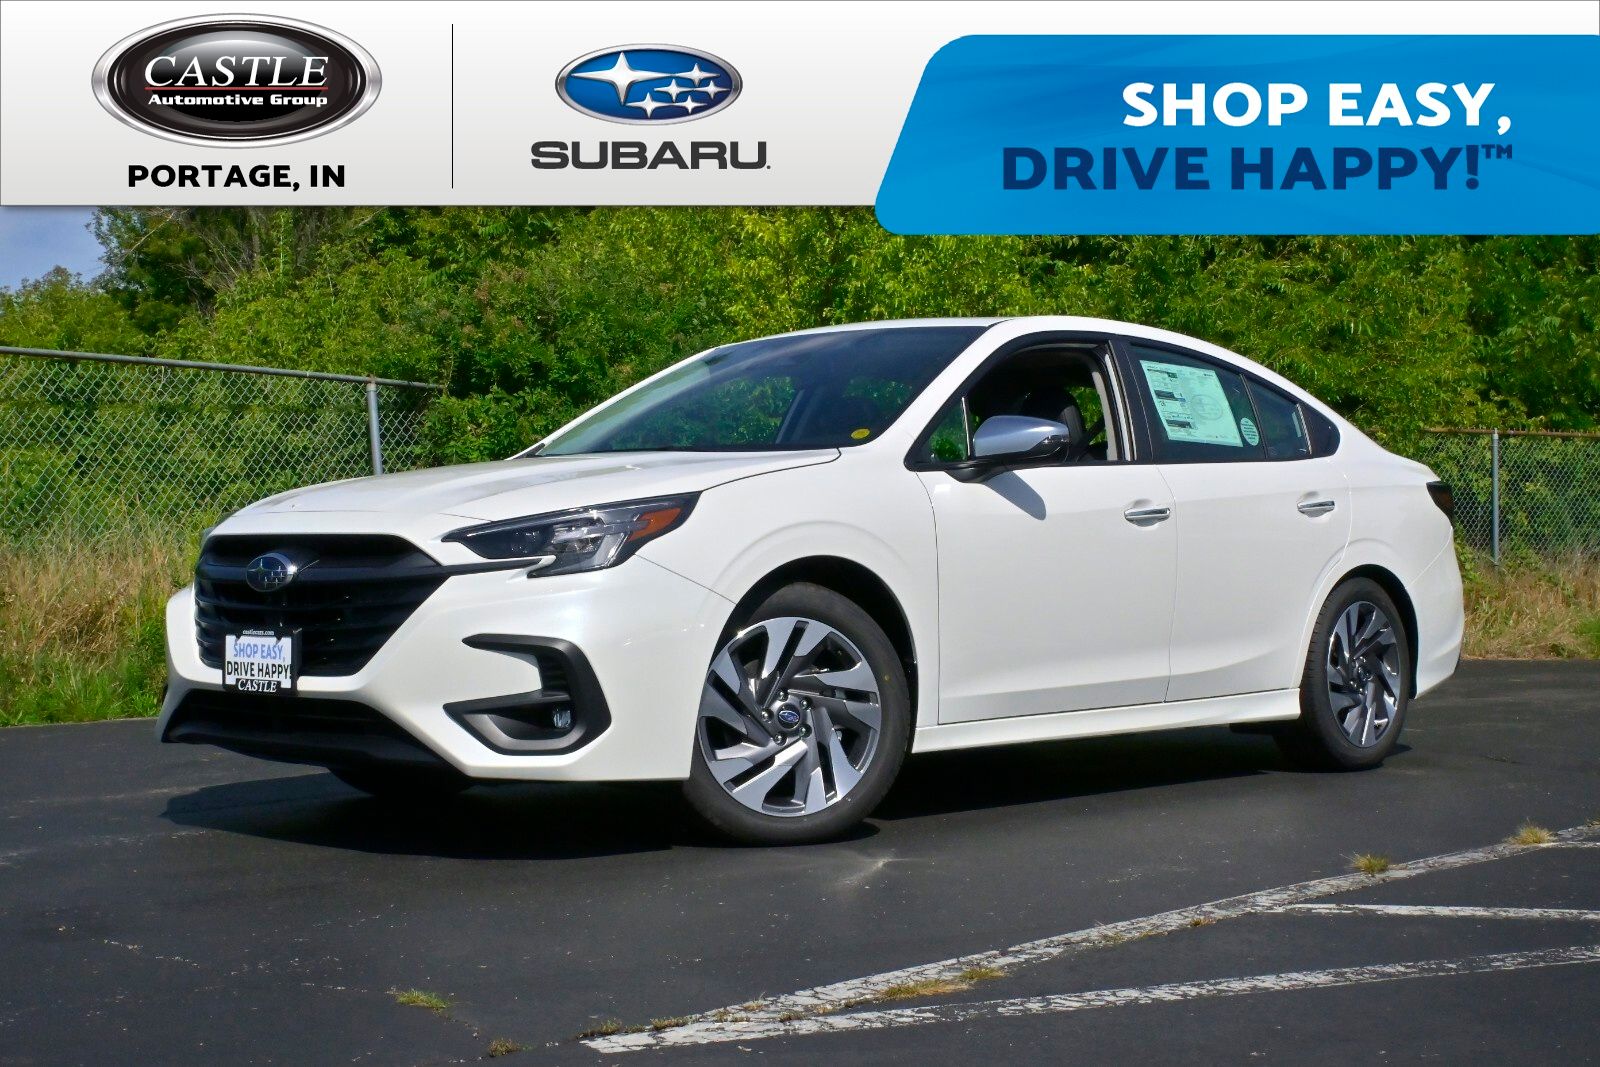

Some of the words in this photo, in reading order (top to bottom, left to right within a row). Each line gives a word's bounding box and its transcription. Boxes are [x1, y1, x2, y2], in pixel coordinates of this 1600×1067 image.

[233, 642, 259, 659] SHOP
[260, 644, 286, 662] EASY,
[226, 661, 255, 677] DRIVE
[237, 679, 278, 693] CASTLE
